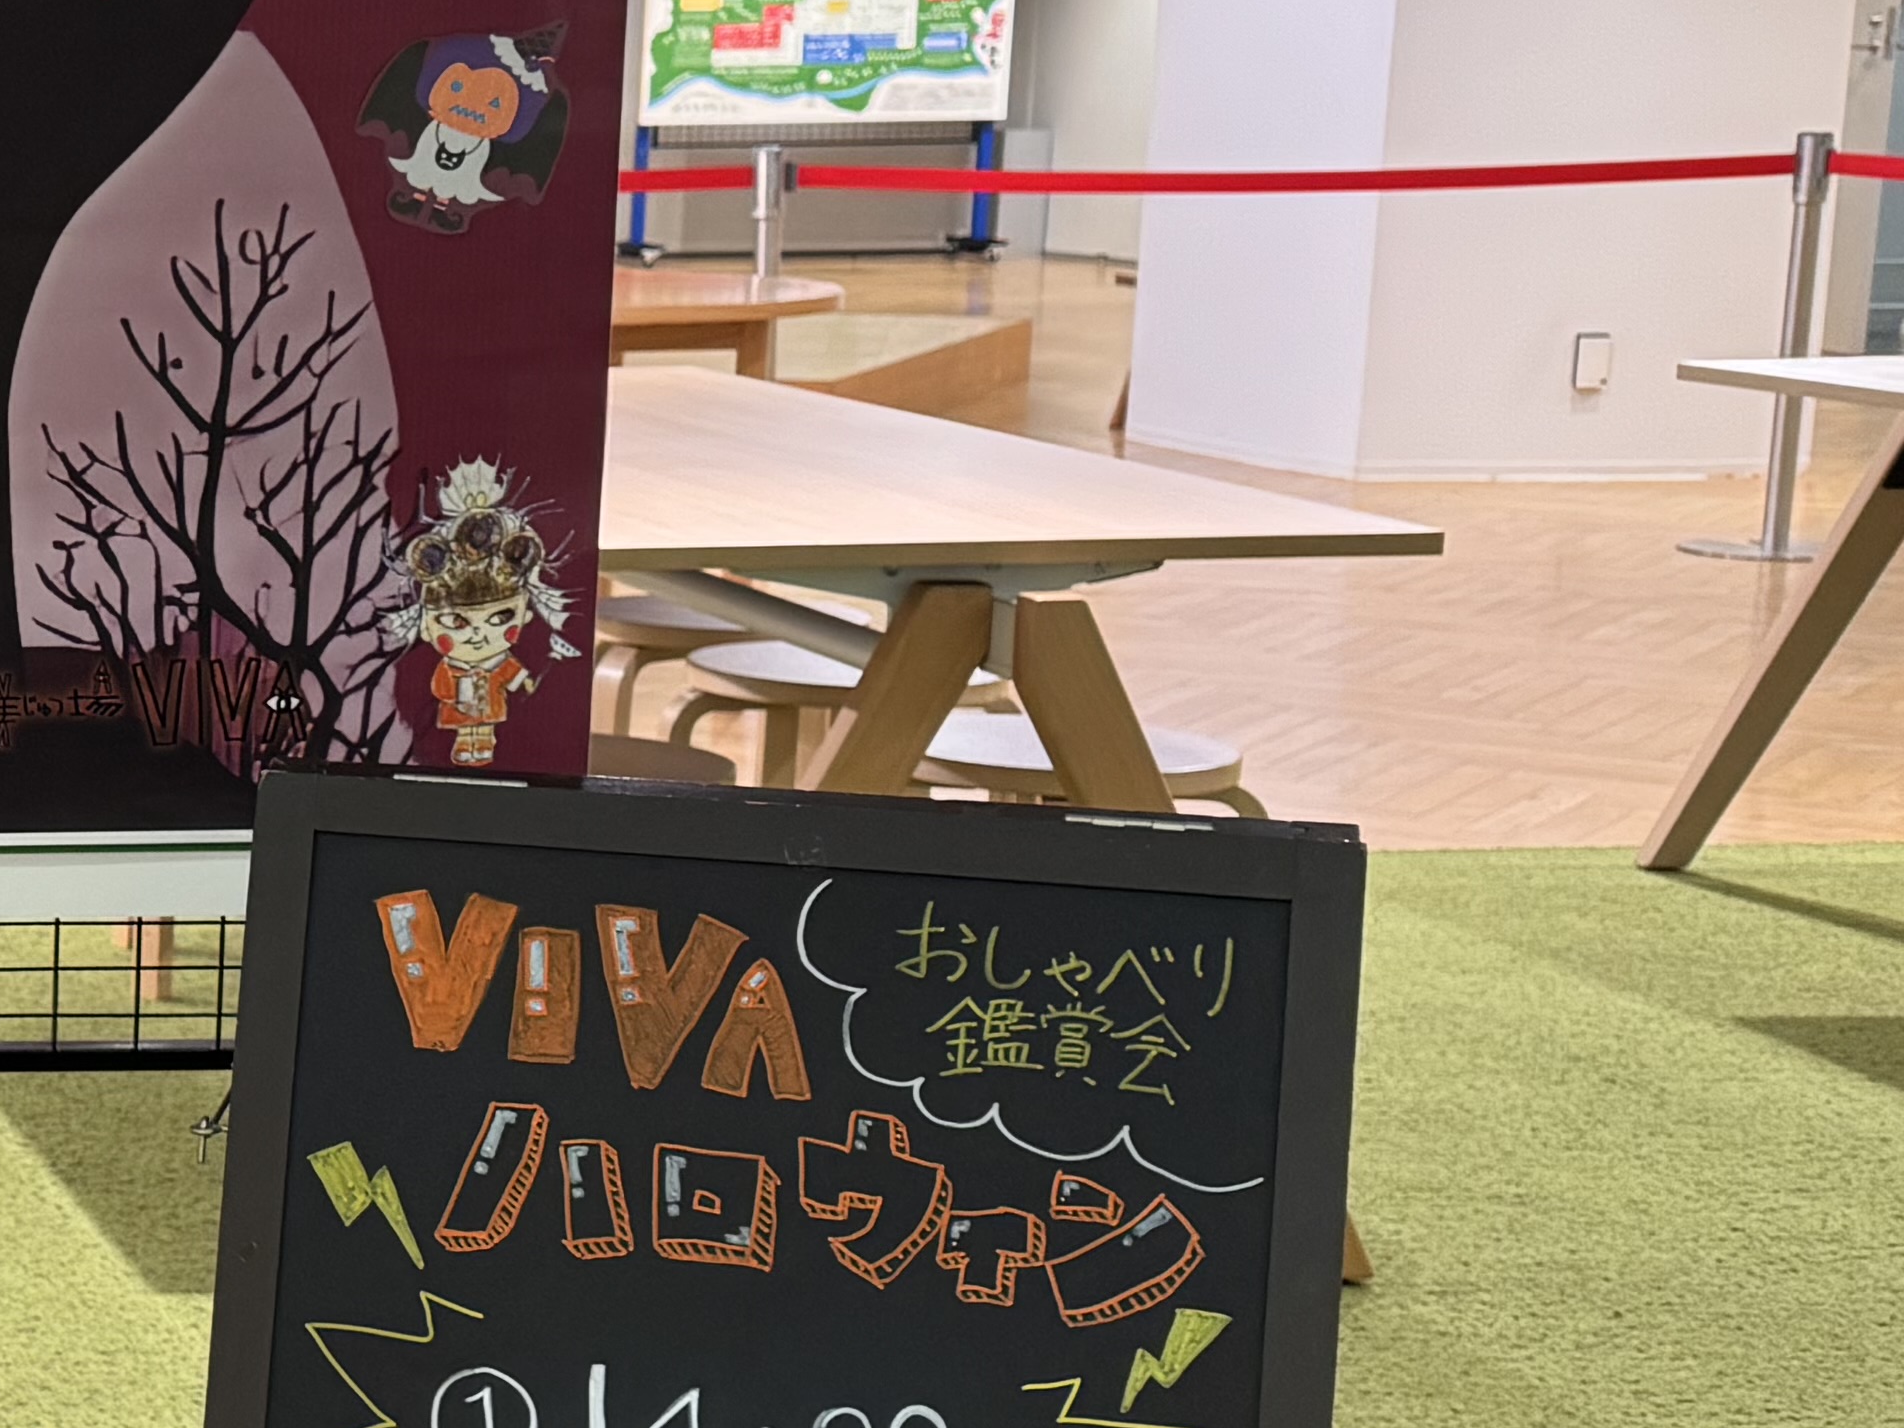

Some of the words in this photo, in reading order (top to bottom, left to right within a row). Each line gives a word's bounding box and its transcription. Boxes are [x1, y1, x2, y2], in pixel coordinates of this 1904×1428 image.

[132, 657, 309, 746] VIVA
[375, 889, 811, 1100] VIVA
[895, 900, 1234, 1018] おしゃべり
[926, 1002, 1190, 1105] 鑑賞会
[434, 1100, 1204, 1327] ハロウィン
